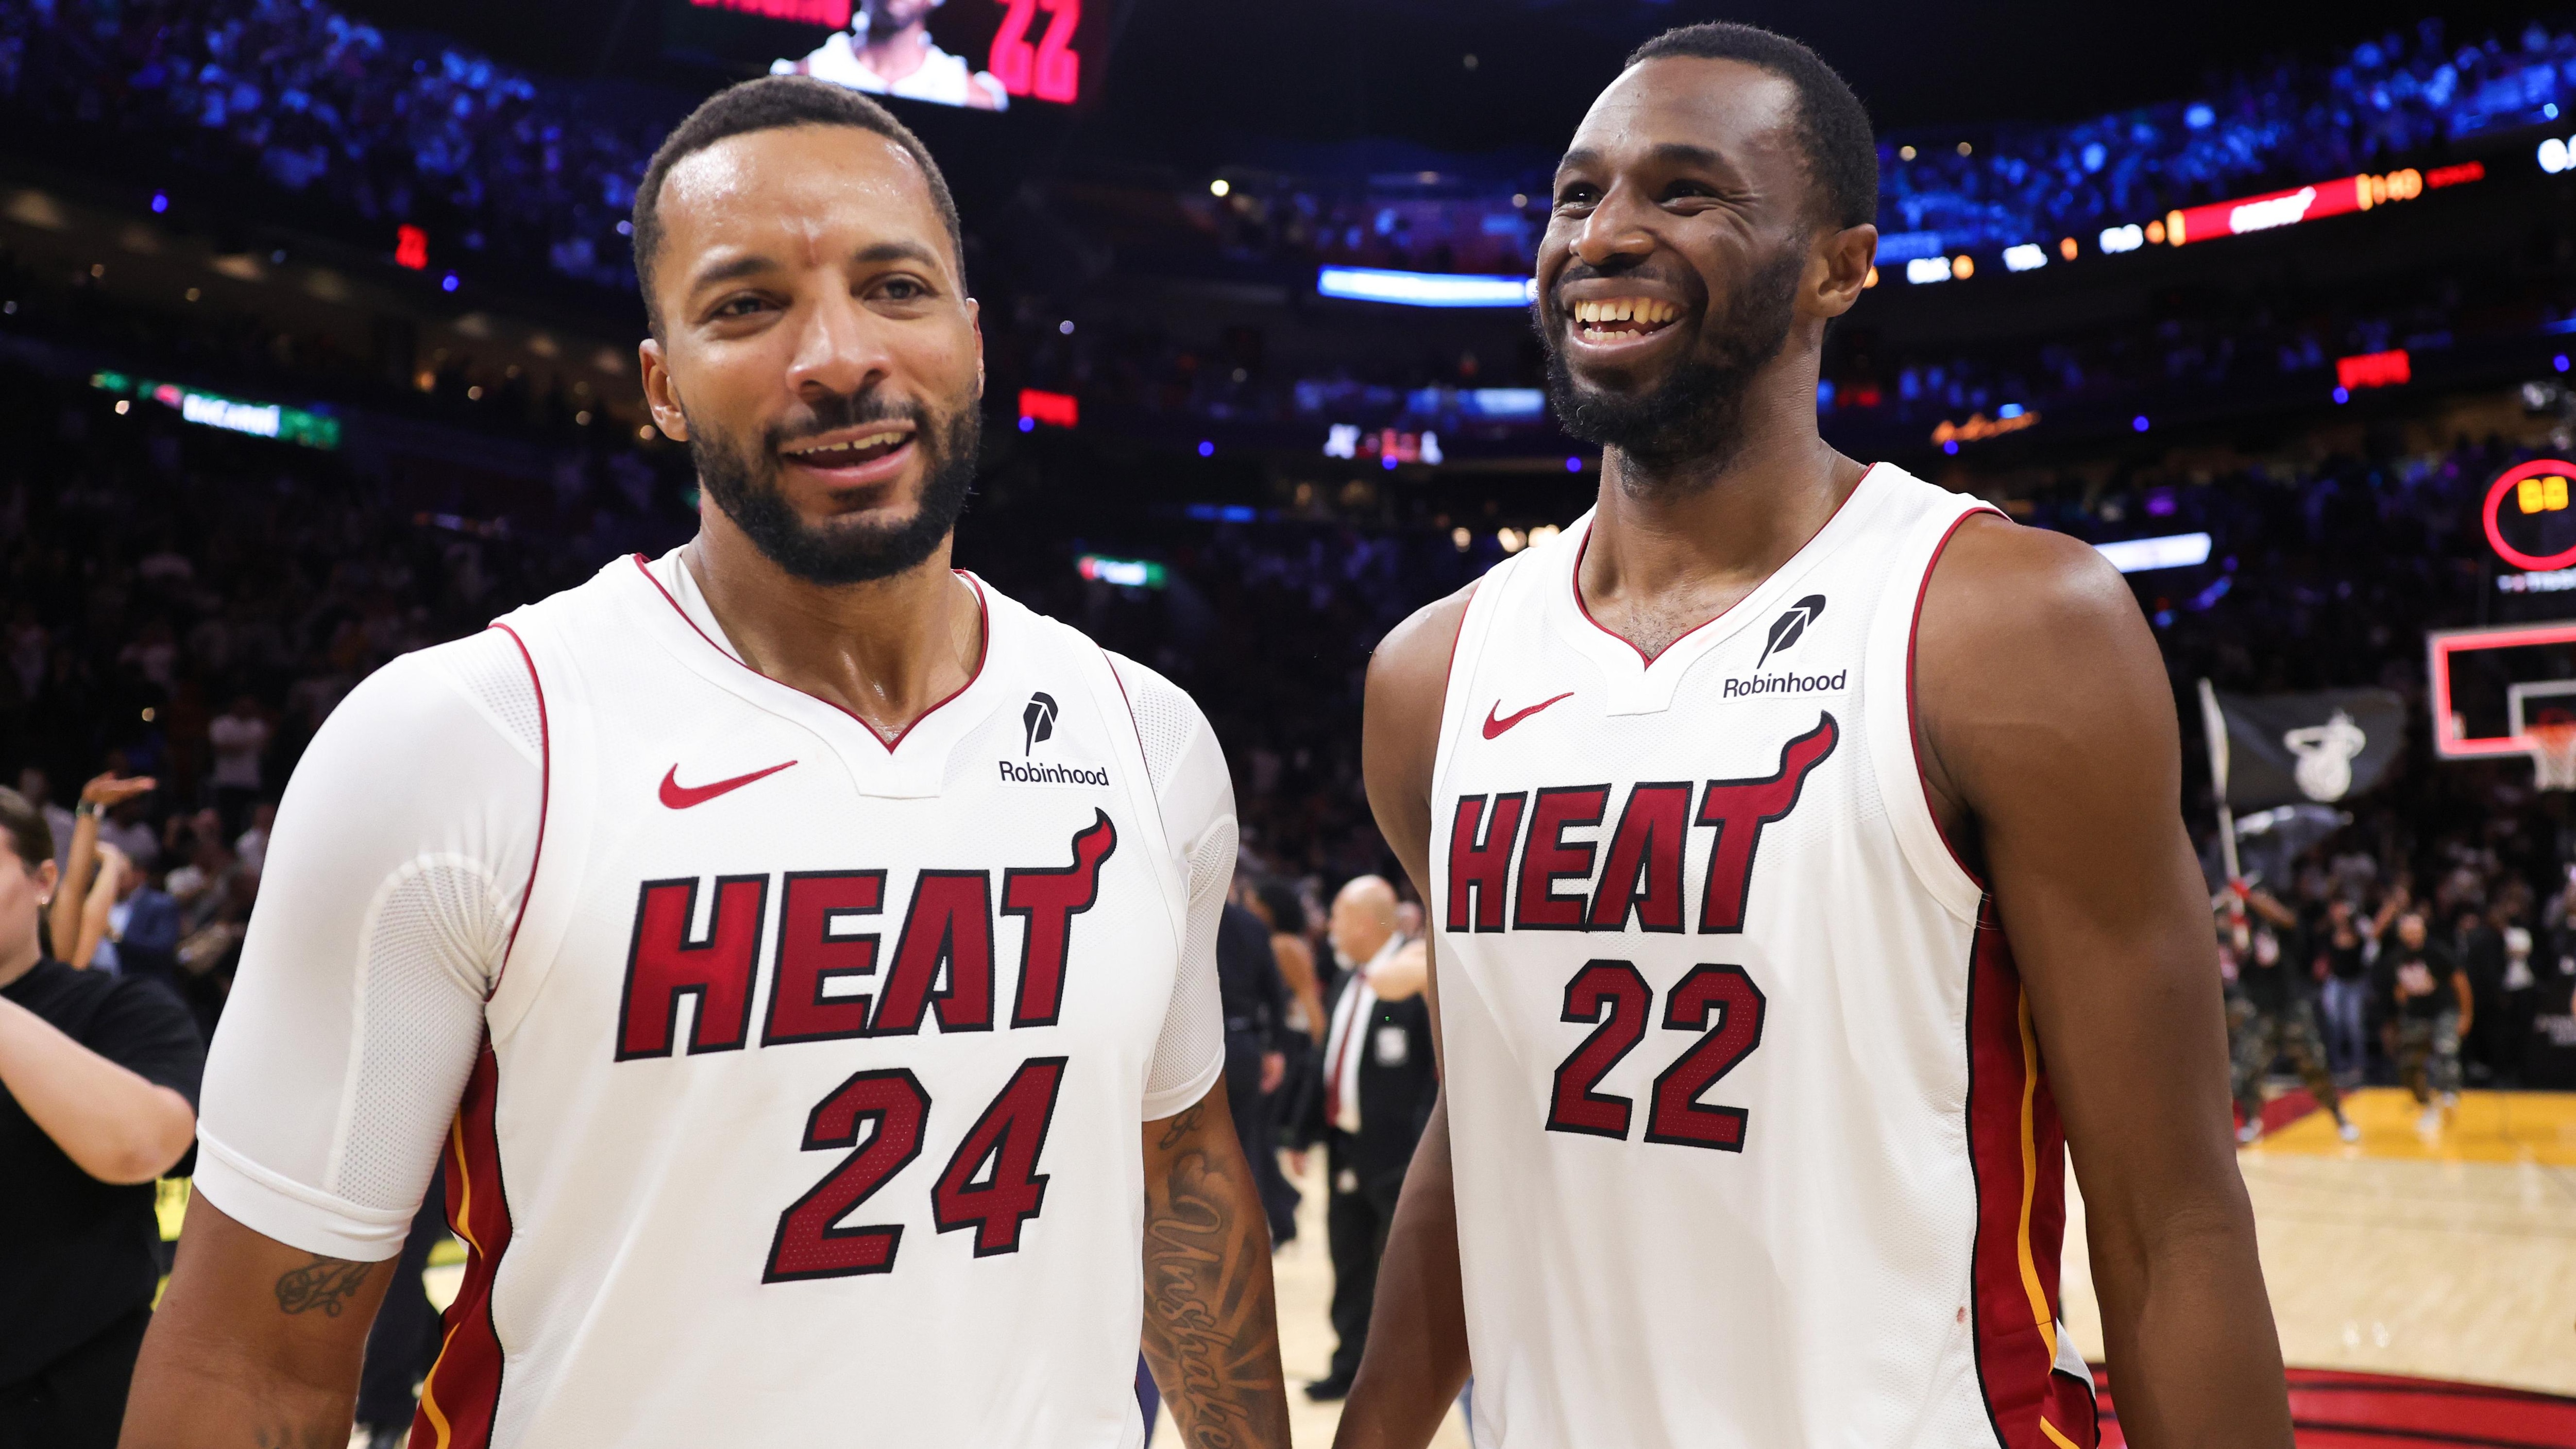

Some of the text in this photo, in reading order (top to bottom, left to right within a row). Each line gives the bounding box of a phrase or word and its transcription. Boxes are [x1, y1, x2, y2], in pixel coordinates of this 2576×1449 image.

[988, 0, 1080, 104] 22
[998, 761, 1109, 786] Robinhood
[1723, 669, 1846, 698] Robinhood
[1446, 709, 1839, 934] HEAT
[614, 807, 1117, 1062] HEAT
[1545, 959, 1766, 1153] 22
[761, 1056, 1069, 1285] 24
